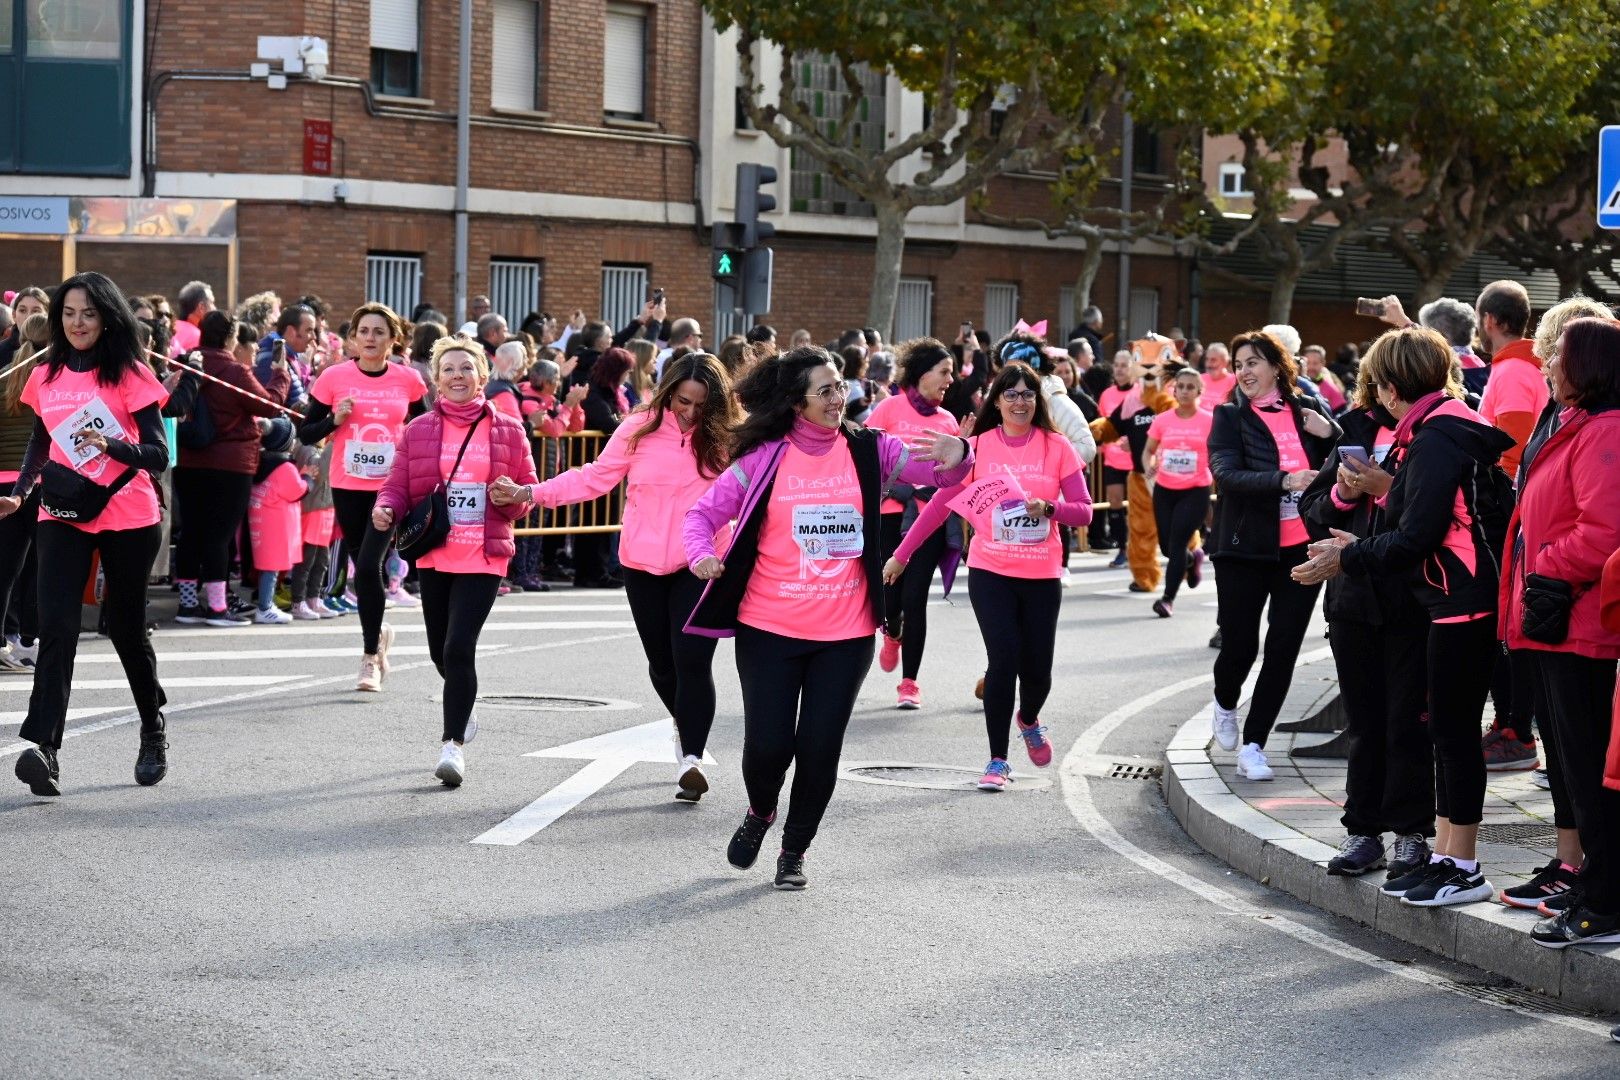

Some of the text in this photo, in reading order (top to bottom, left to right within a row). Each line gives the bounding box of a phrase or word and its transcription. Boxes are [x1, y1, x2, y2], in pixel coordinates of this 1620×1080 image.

[0, 207, 51, 220] OSIVOS
[353, 453, 385, 465] 5949
[1003, 516, 1040, 528] 0729
[798, 523, 856, 535] MADRINA
